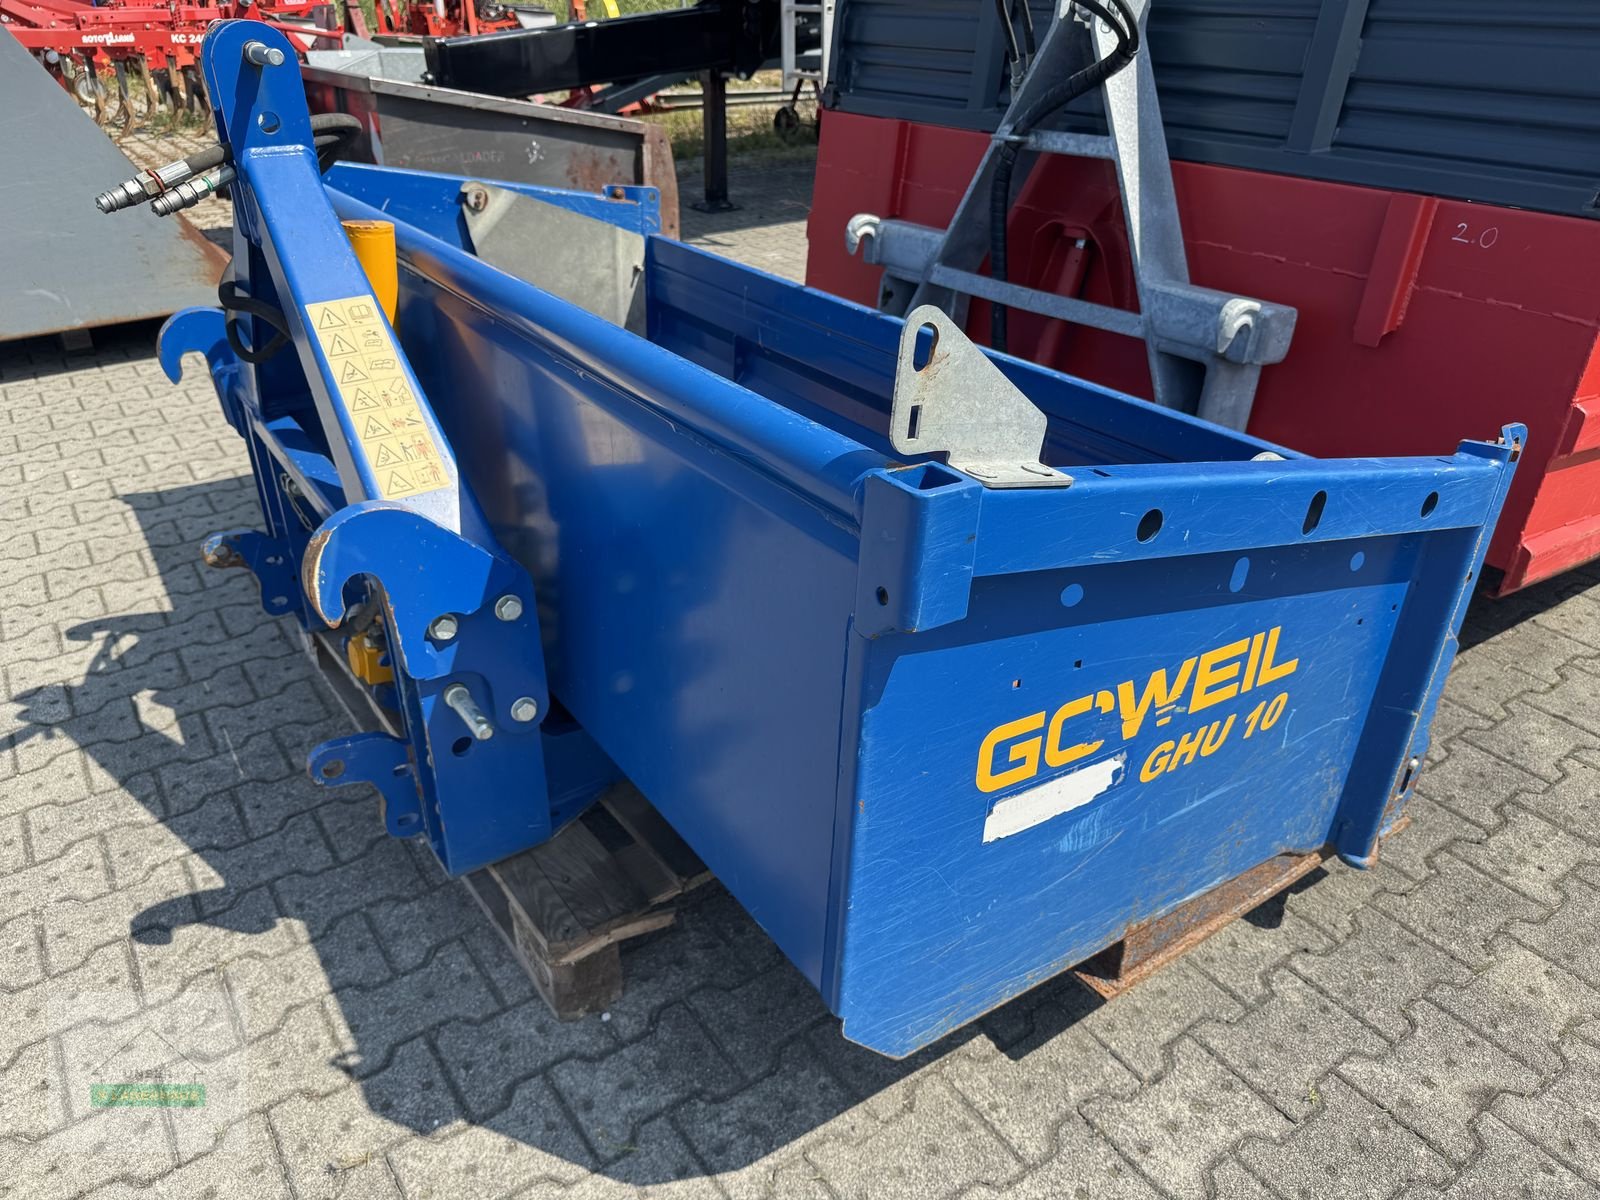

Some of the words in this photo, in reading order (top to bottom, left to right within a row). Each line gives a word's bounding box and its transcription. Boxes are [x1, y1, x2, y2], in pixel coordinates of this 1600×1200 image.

[170, 33, 187, 44] KC
[1451, 222, 1499, 248] 2.0
[1140, 713, 1236, 783] GHU
[1242, 691, 1289, 740] 10
